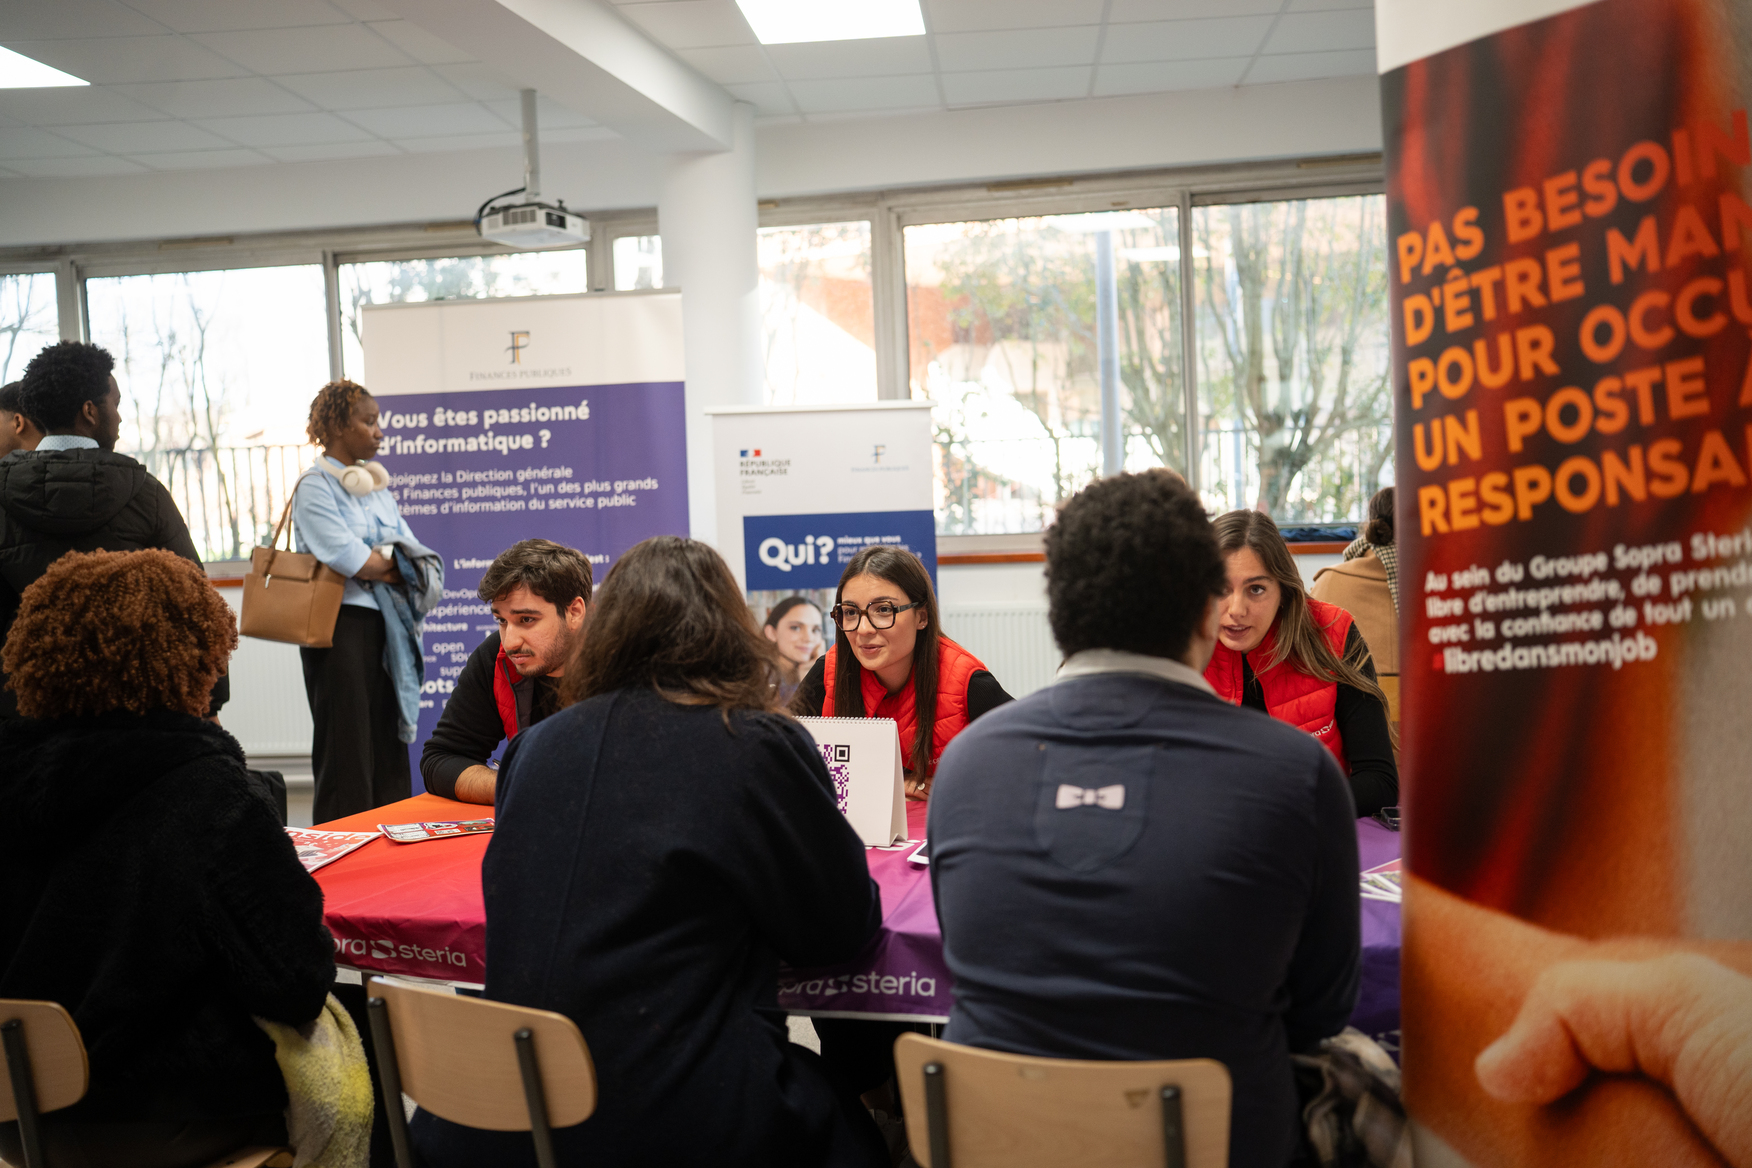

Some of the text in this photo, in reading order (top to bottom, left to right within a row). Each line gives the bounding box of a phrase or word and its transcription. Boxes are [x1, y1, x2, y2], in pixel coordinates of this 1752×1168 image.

[1397, 108, 1751, 284] PAS BESOIN
[1403, 192, 1752, 347] D'ÊTRE MAN
[1408, 268, 1752, 411] POUR OCCU
[377, 400, 590, 430] Vous êtes passionné
[1413, 408, 1483, 472] UN
[1504, 356, 1711, 453] POSTE
[388, 465, 573, 488] ejoignez la Direction générale
[403, 487, 459, 501] Finances
[462, 482, 527, 500] publiques,
[557, 480, 581, 494] des
[584, 479, 611, 495] plus
[613, 476, 659, 493] grands
[1418, 429, 1747, 537] RESPONSA
[399, 502, 438, 516] tèmes
[528, 498, 546, 511] du
[548, 495, 595, 510] service
[597, 493, 637, 510] public
[1425, 596, 1465, 619] libre
[1630, 570, 1663, 597] de
[1670, 561, 1752, 598] prend
[1451, 563, 1491, 590] sein
[1494, 559, 1525, 585] du
[1529, 552, 1609, 580] Groupe
[1613, 542, 1683, 571] Sopra
[1428, 623, 1471, 645] avec
[1500, 609, 1604, 638] confiance
[1608, 602, 1638, 629] de
[1701, 597, 1736, 620] un
[432, 642, 465, 655] open
[399, 944, 467, 967] steria
[851, 971, 936, 997] steria
